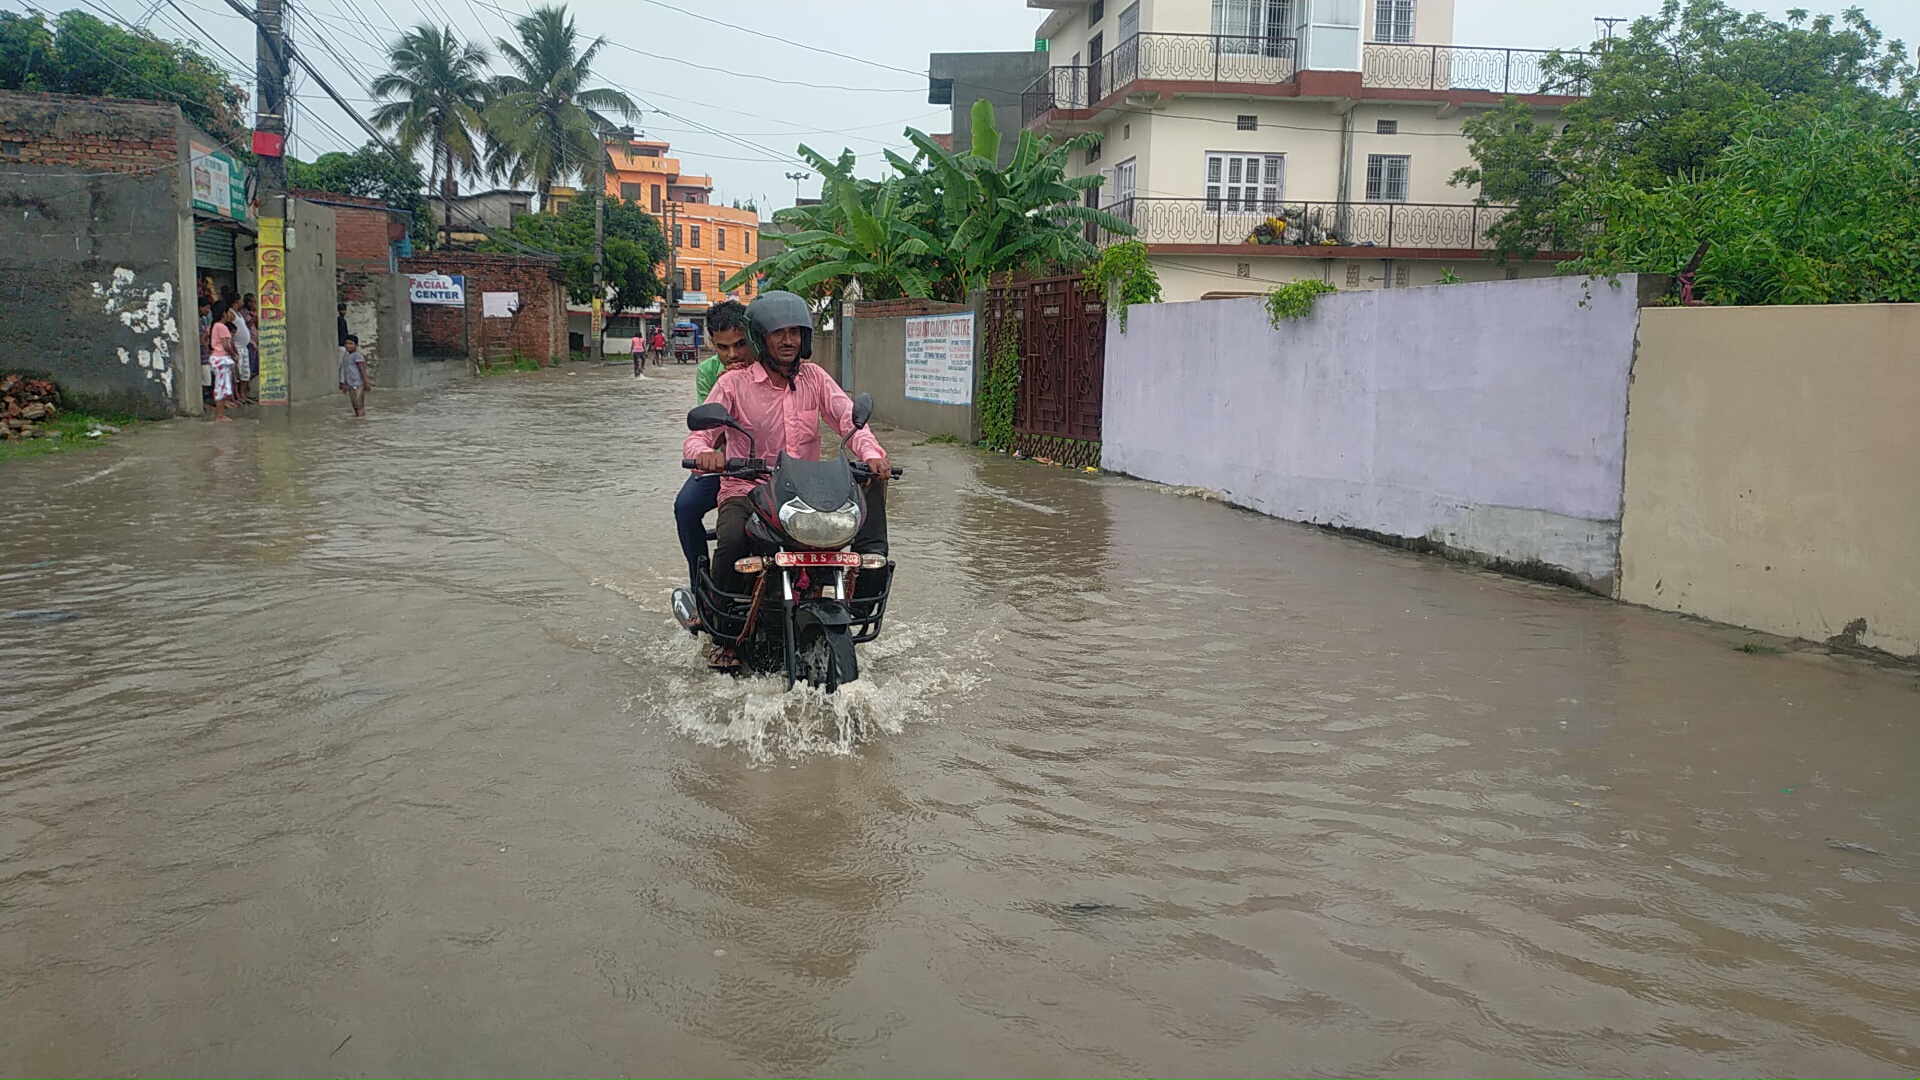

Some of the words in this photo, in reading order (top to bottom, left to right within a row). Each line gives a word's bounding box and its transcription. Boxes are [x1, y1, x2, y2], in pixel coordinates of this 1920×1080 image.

[261, 249, 284, 320] GRAND
[409, 278, 448, 289] FACIAL
[415, 290, 459, 299] CENTER
[951, 319, 971, 336] CENTRE
